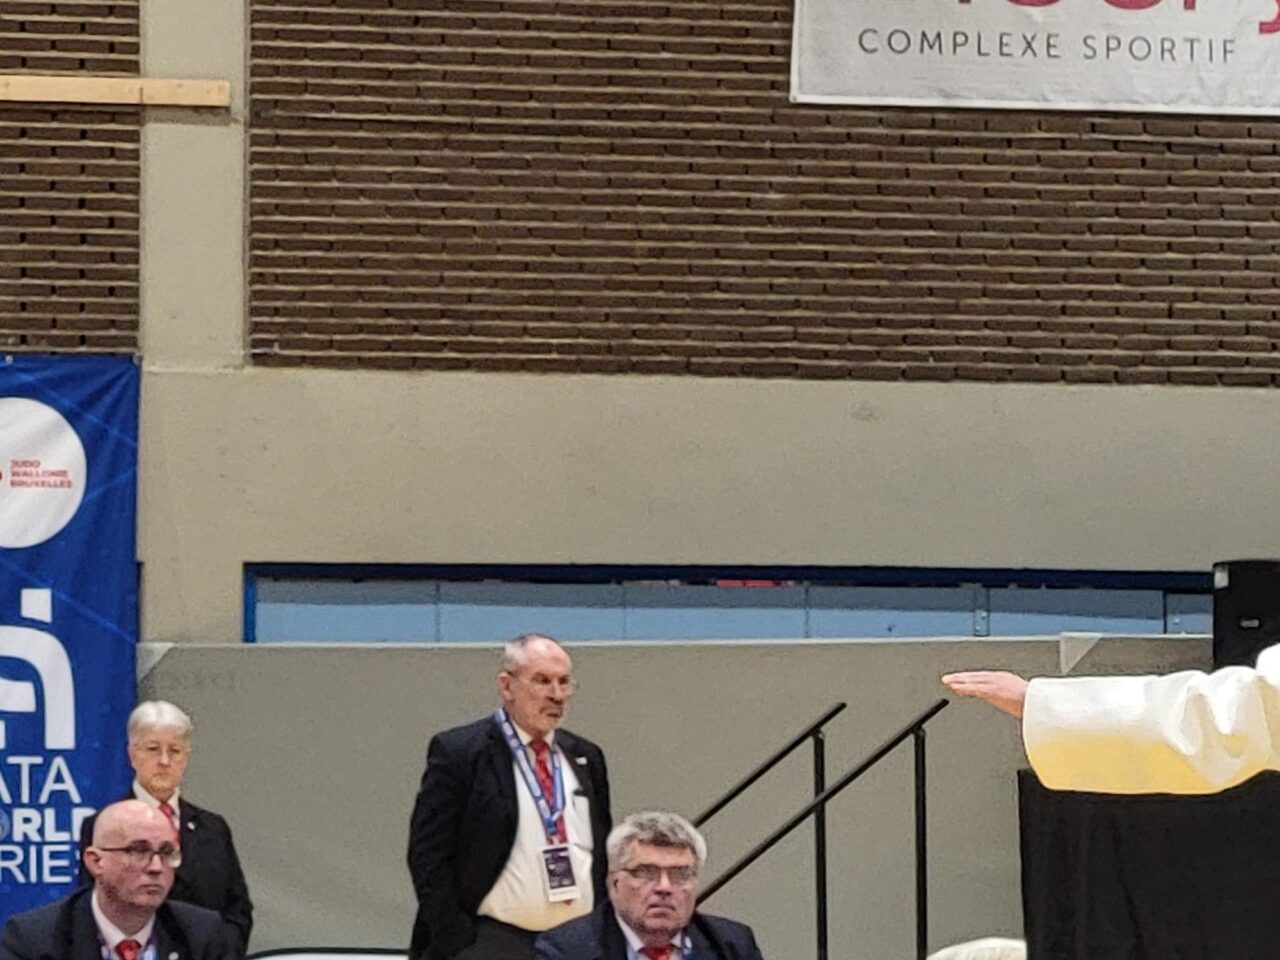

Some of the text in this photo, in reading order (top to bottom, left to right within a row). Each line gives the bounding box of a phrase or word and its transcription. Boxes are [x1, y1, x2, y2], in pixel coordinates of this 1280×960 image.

[858, 28, 1237, 64] COMPLEXE SPORTIF
[0, 844, 80, 884] RIE
